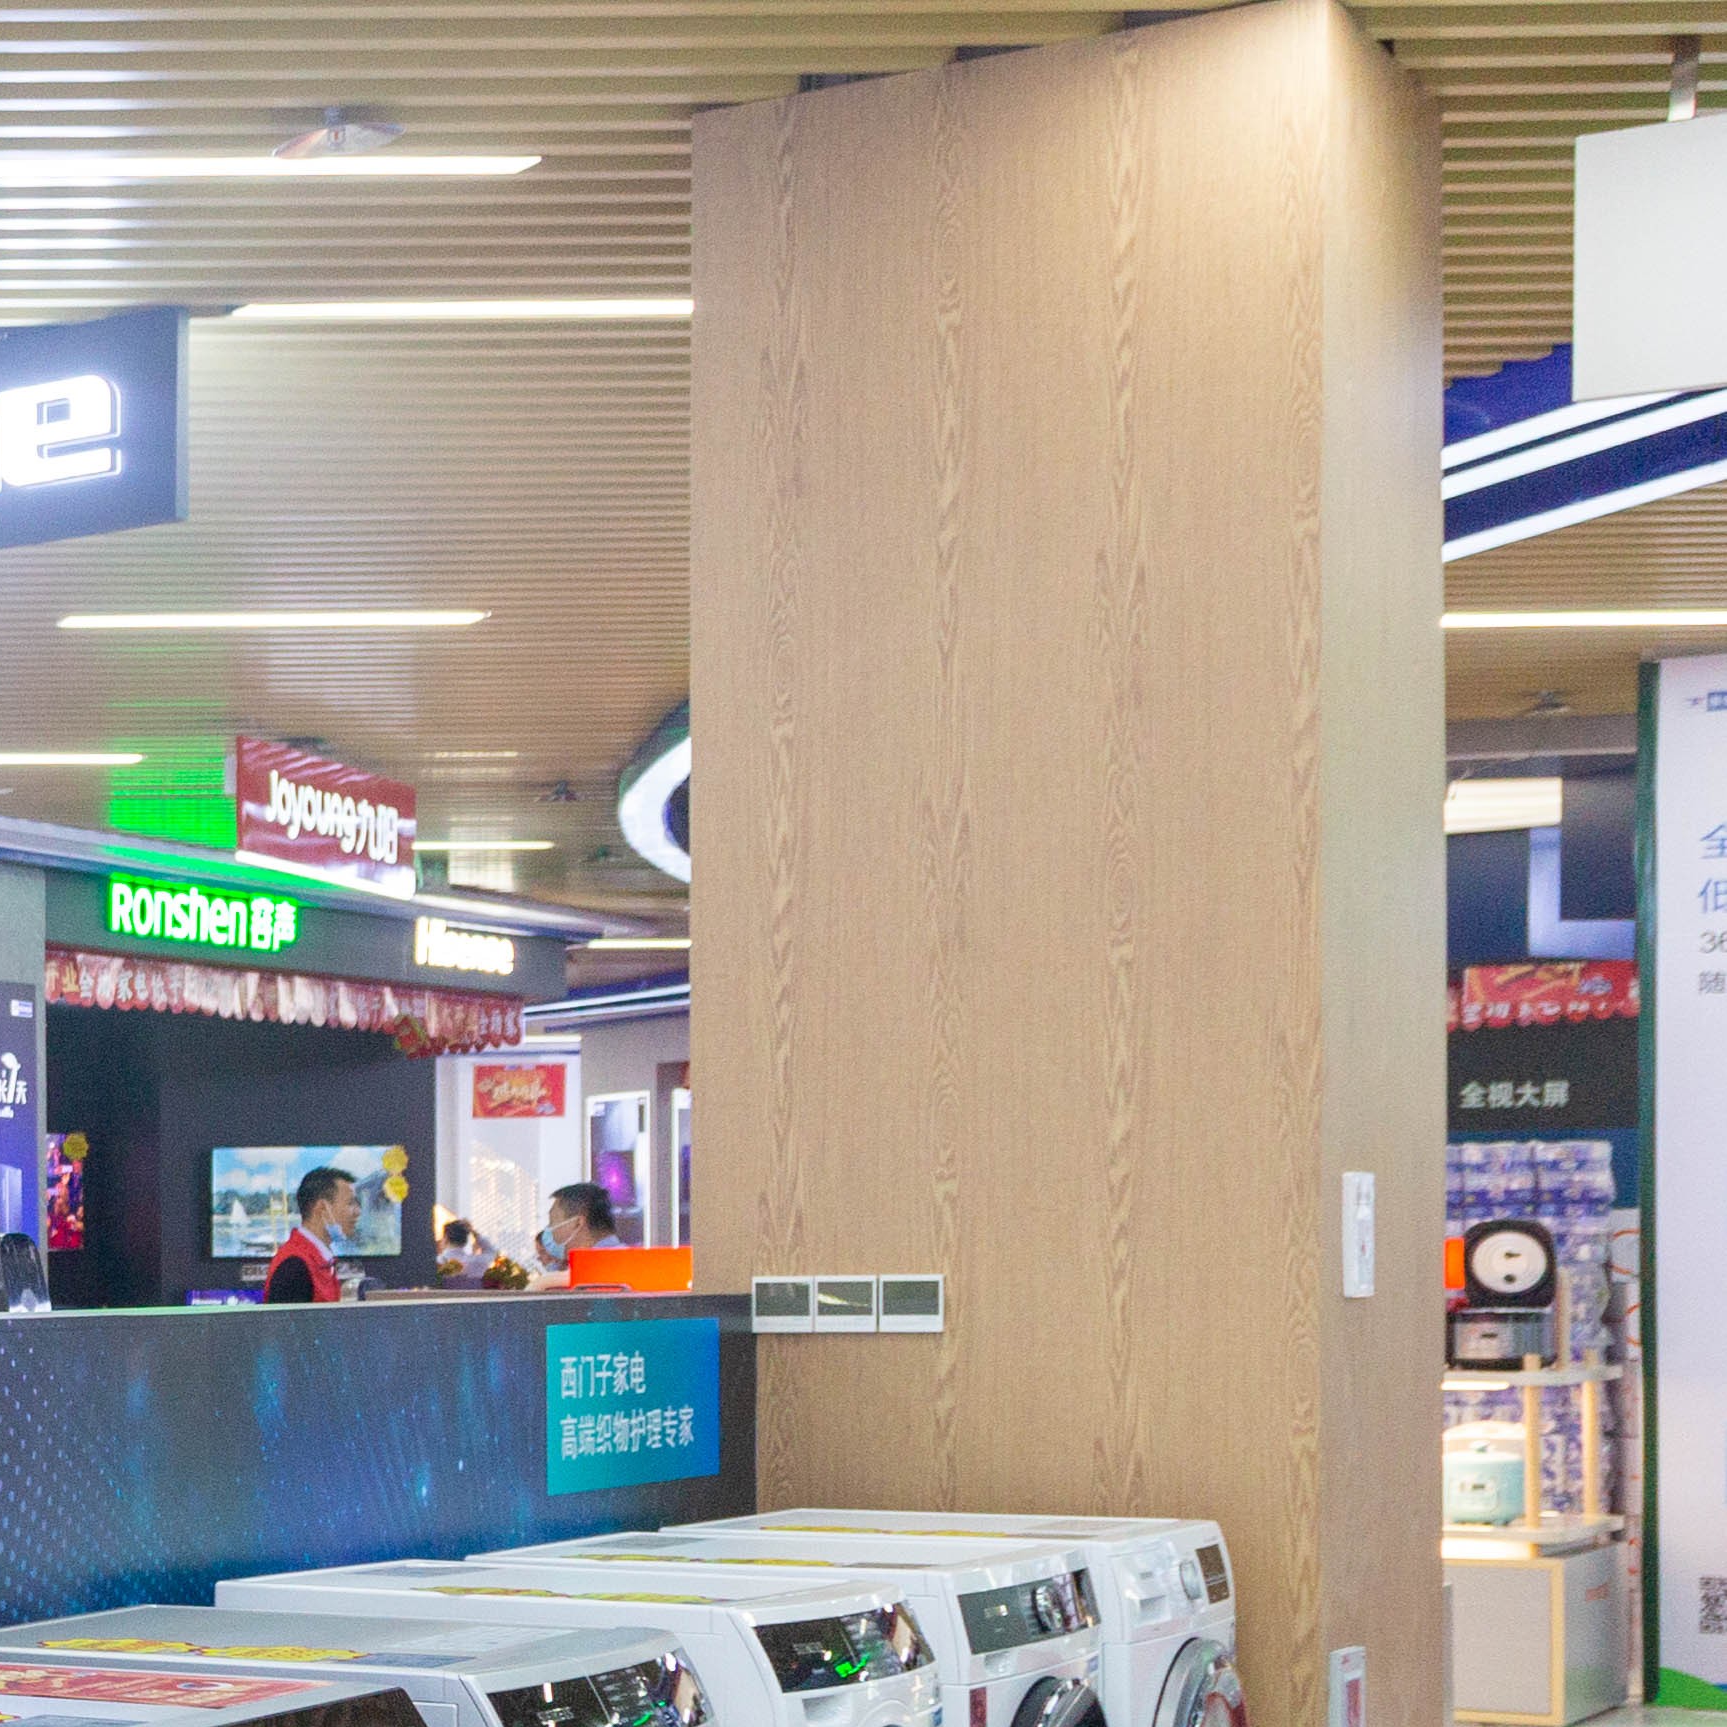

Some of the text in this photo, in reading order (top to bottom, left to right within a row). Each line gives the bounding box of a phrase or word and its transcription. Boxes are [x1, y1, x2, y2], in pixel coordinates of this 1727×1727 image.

[264, 769, 358, 855] Joyoung
[111, 881, 297, 952] Ronshen 容声
[560, 1350, 647, 1400] 西门子家电
[560, 1405, 695, 1461] 高端织物护理专家
